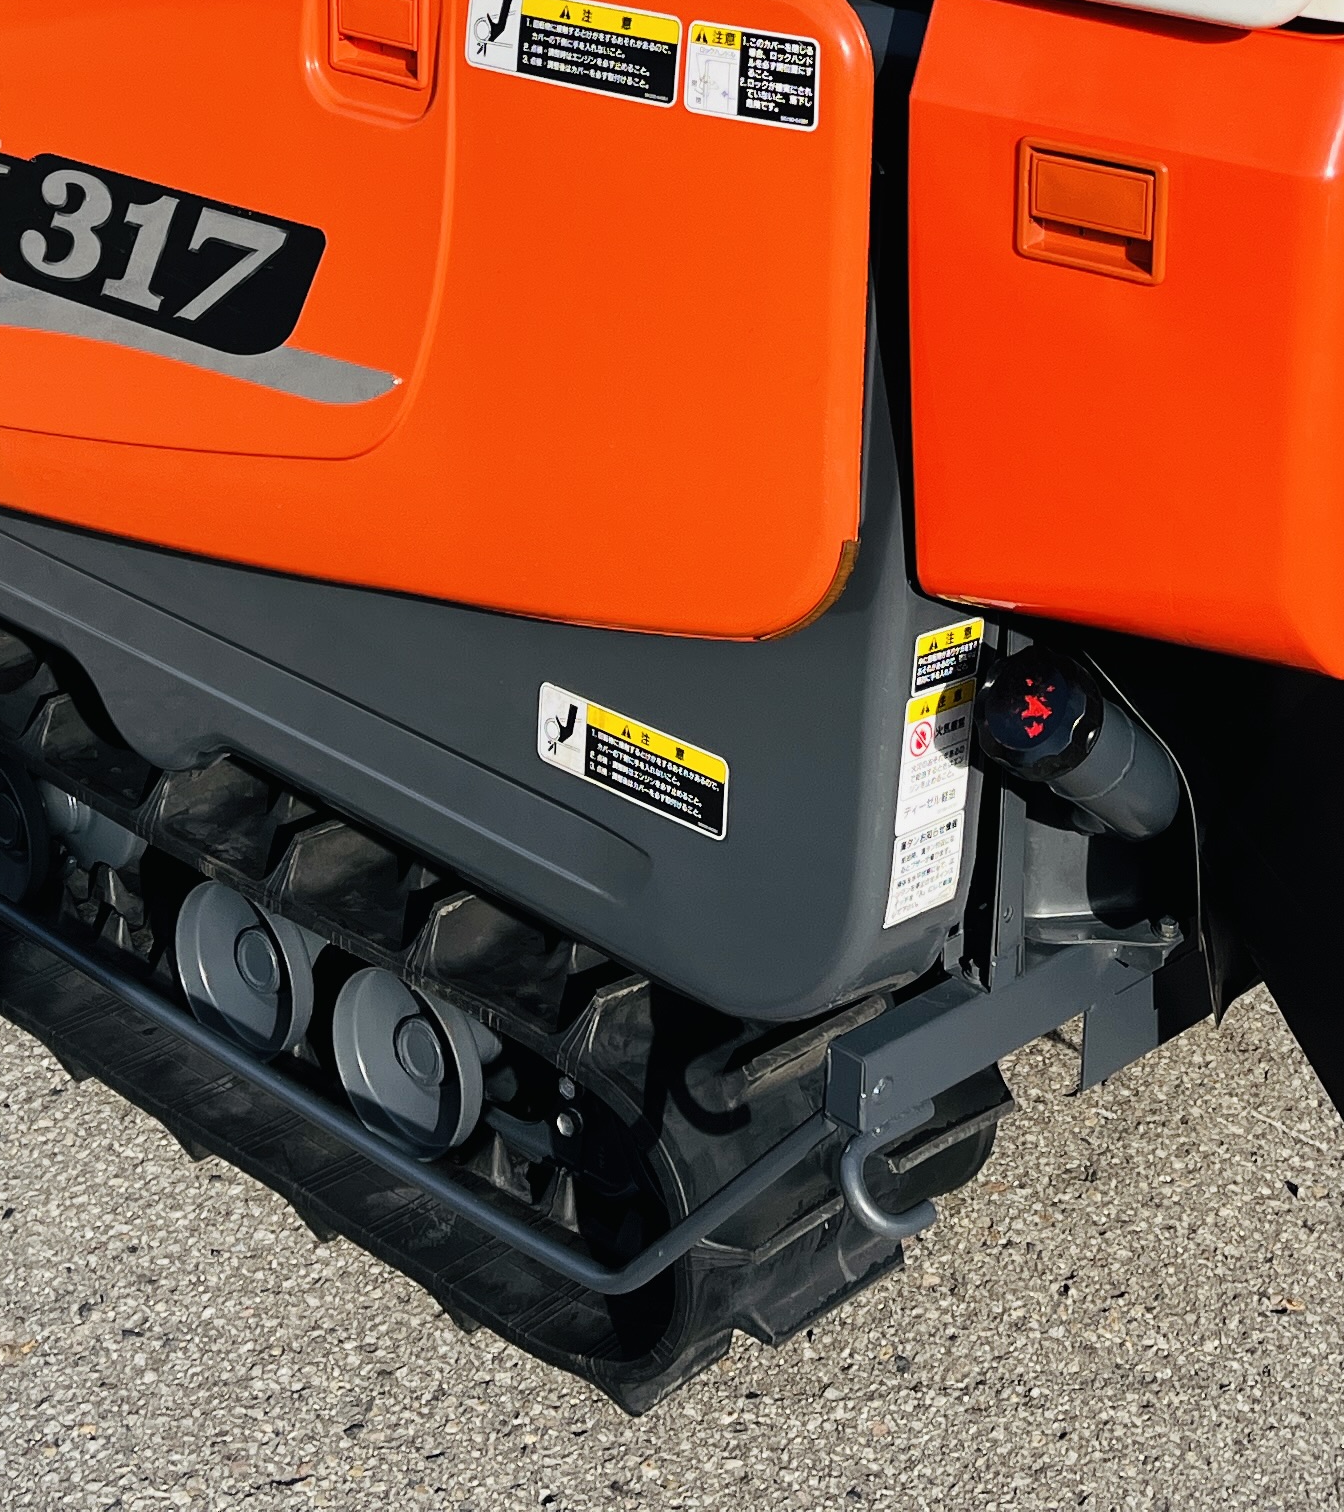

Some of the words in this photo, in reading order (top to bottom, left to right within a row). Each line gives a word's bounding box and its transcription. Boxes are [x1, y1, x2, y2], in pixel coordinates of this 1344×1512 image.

[581, 8, 633, 30] 注意
[712, 30, 736, 46] 注意
[19, 169, 289, 322] 317
[945, 626, 973, 645] 注意
[640, 731, 685, 761] 注意
